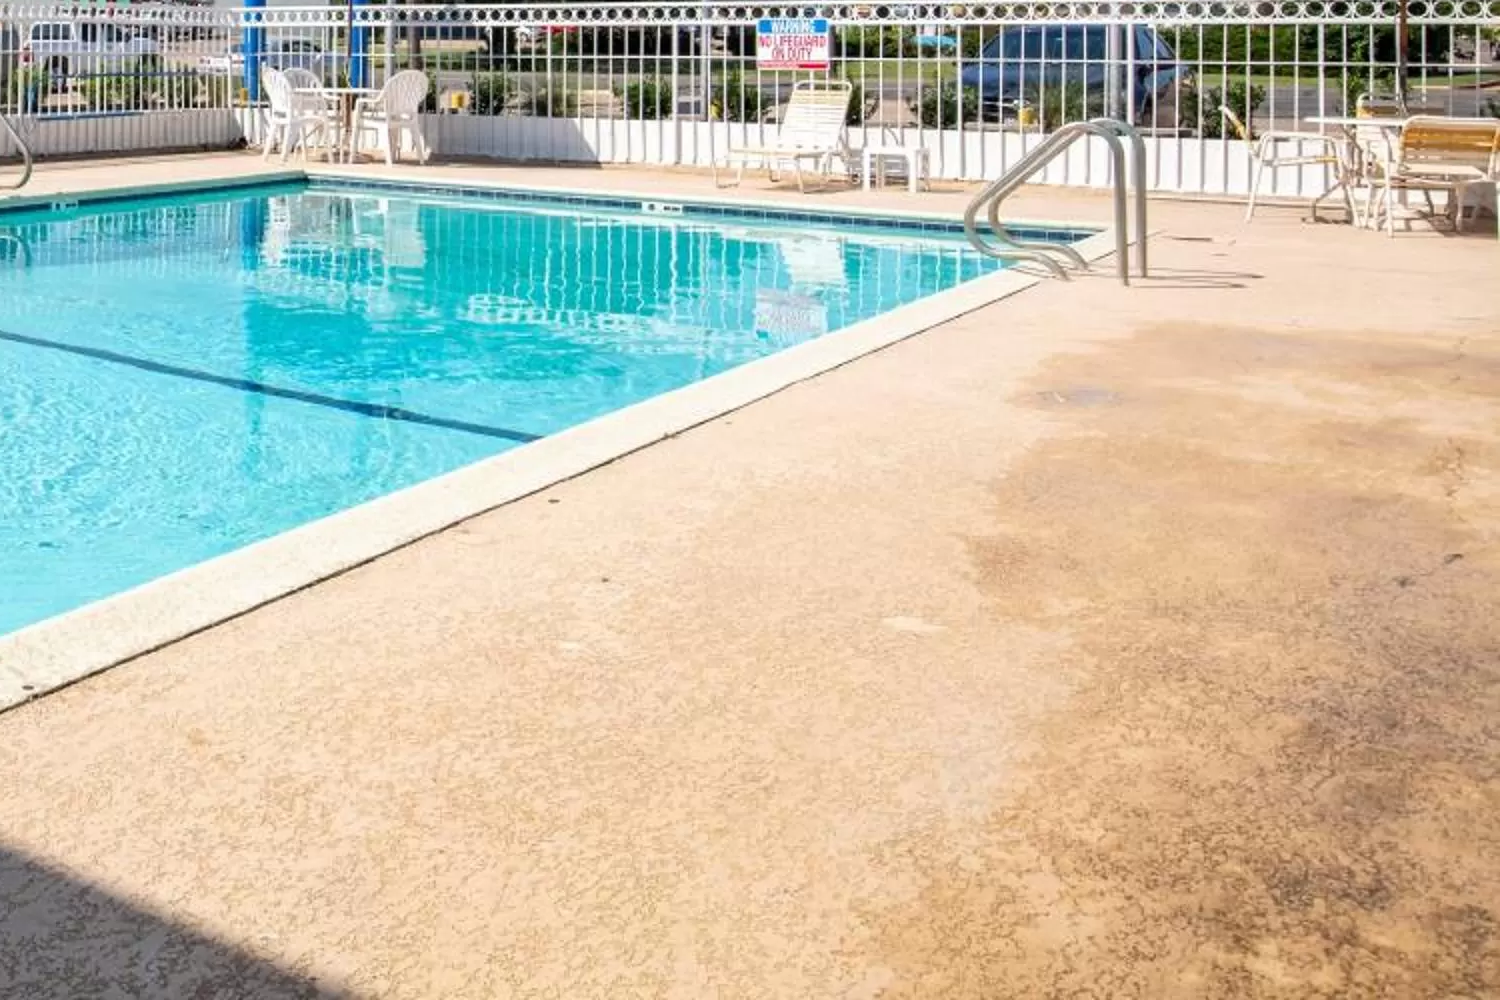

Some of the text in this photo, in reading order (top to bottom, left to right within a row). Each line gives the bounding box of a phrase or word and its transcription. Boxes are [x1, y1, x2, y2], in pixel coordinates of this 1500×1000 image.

[758, 35, 826, 48] NO LIFEGUARD
[771, 47, 813, 60] ON DUTY
